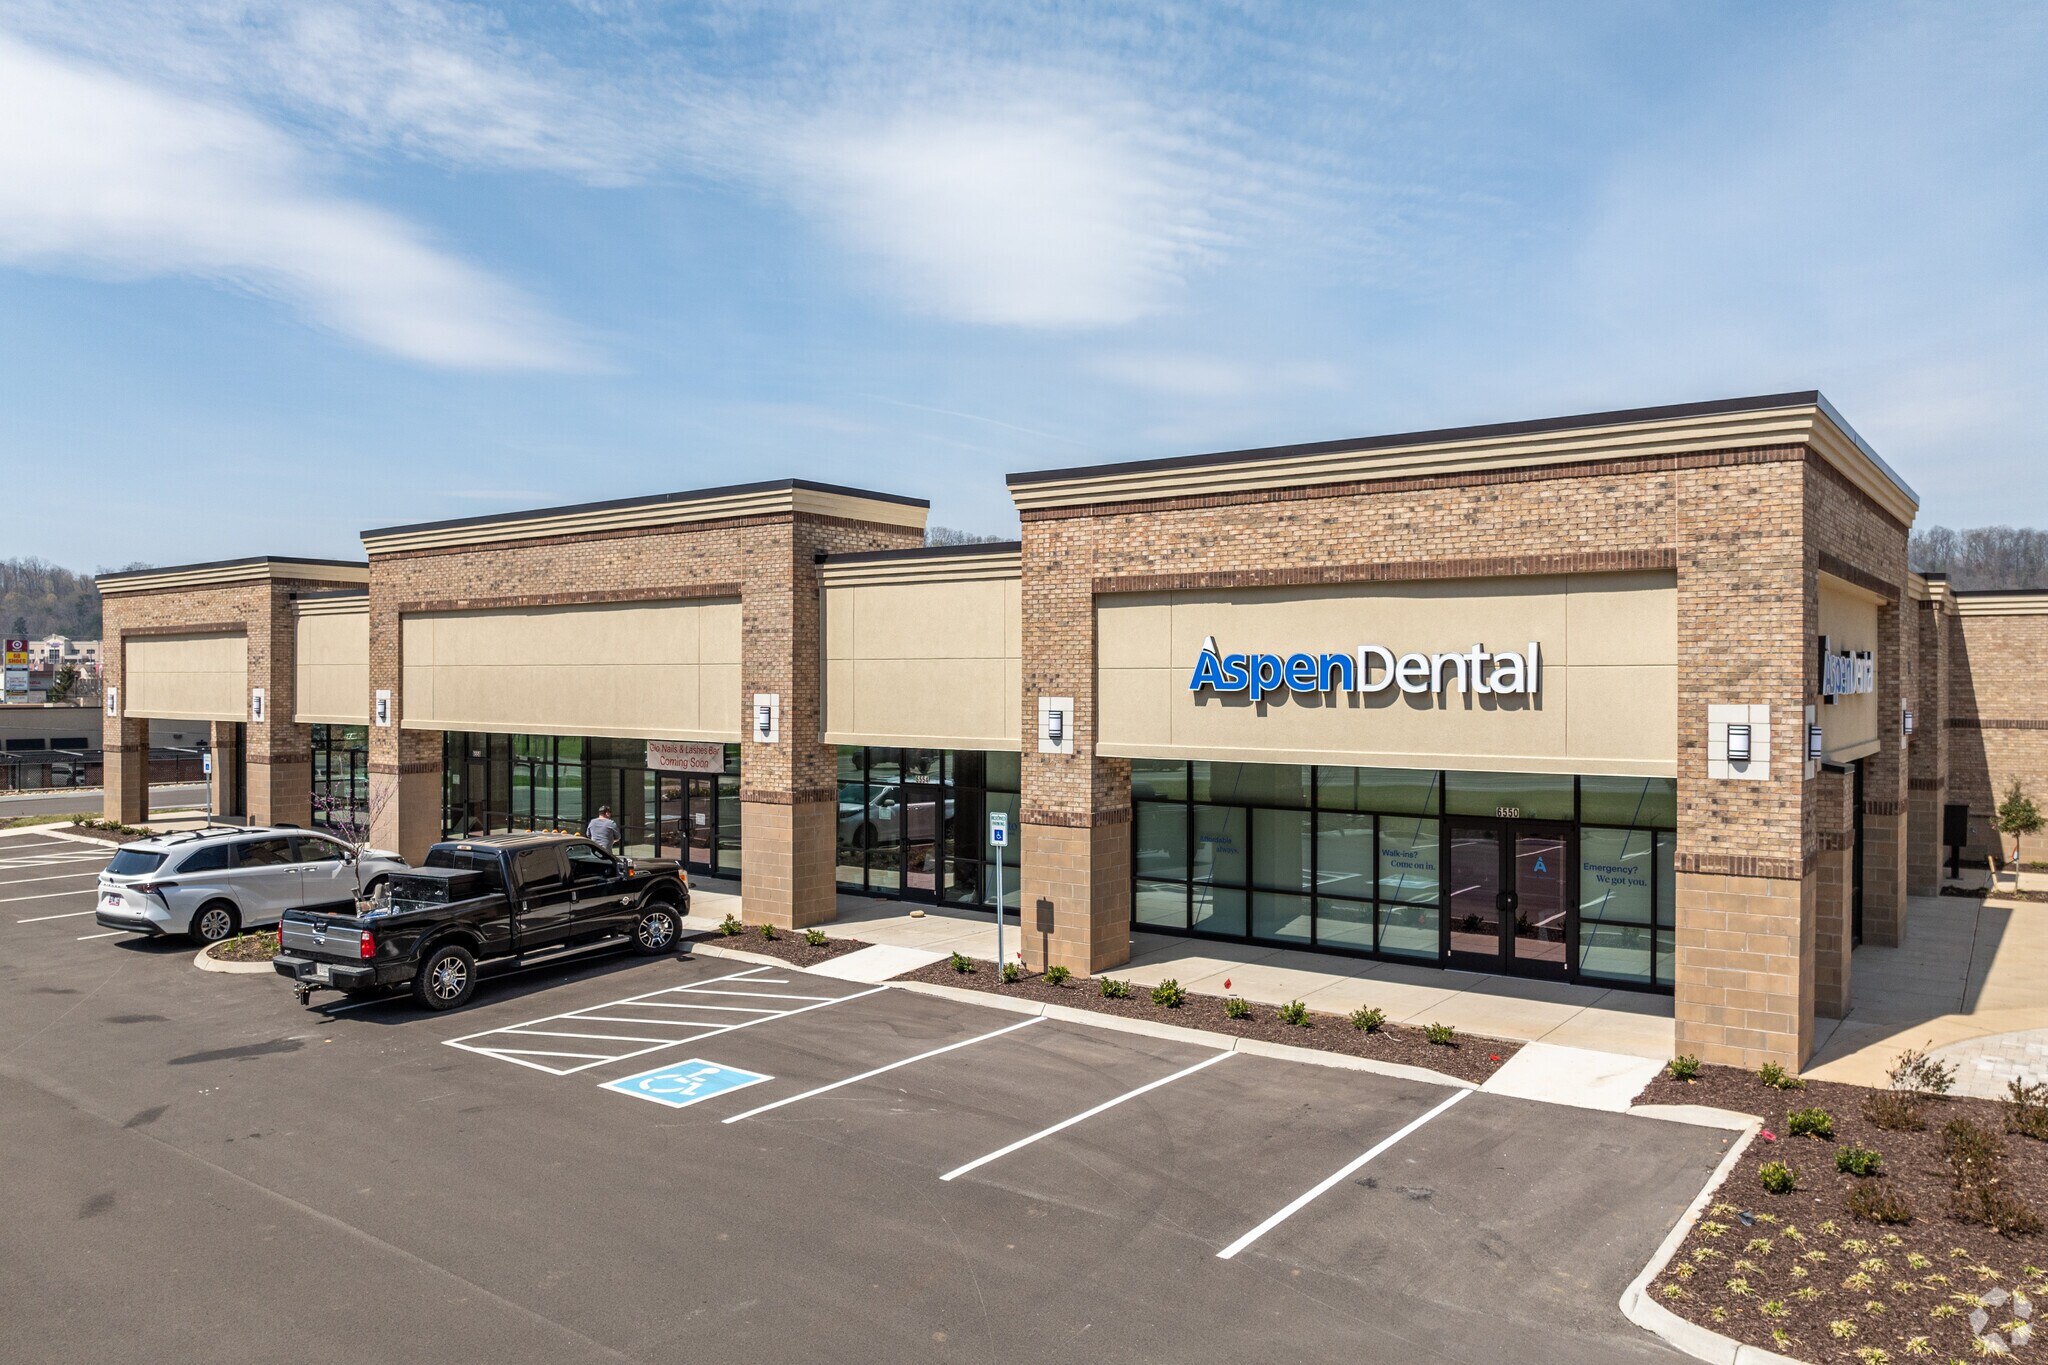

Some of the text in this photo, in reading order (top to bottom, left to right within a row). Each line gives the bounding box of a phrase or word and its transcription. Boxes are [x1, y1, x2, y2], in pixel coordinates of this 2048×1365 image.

[1189, 635, 1542, 702] AspenDental
[661, 744, 677, 753] Nails
[679, 744, 684, 753] &
[685, 745, 707, 755] Lashes
[708, 746, 720, 755] Bar
[660, 755, 709, 769] Coming Soon
[1497, 807, 1519, 818] 6550
[1381, 849, 1418, 859] Walk-ins?
[1391, 860, 1413, 868] Come
[1426, 861, 1436, 870] in.
[1583, 862, 1639, 875] Emergency?
[1596, 874, 1647, 887] We got you.
